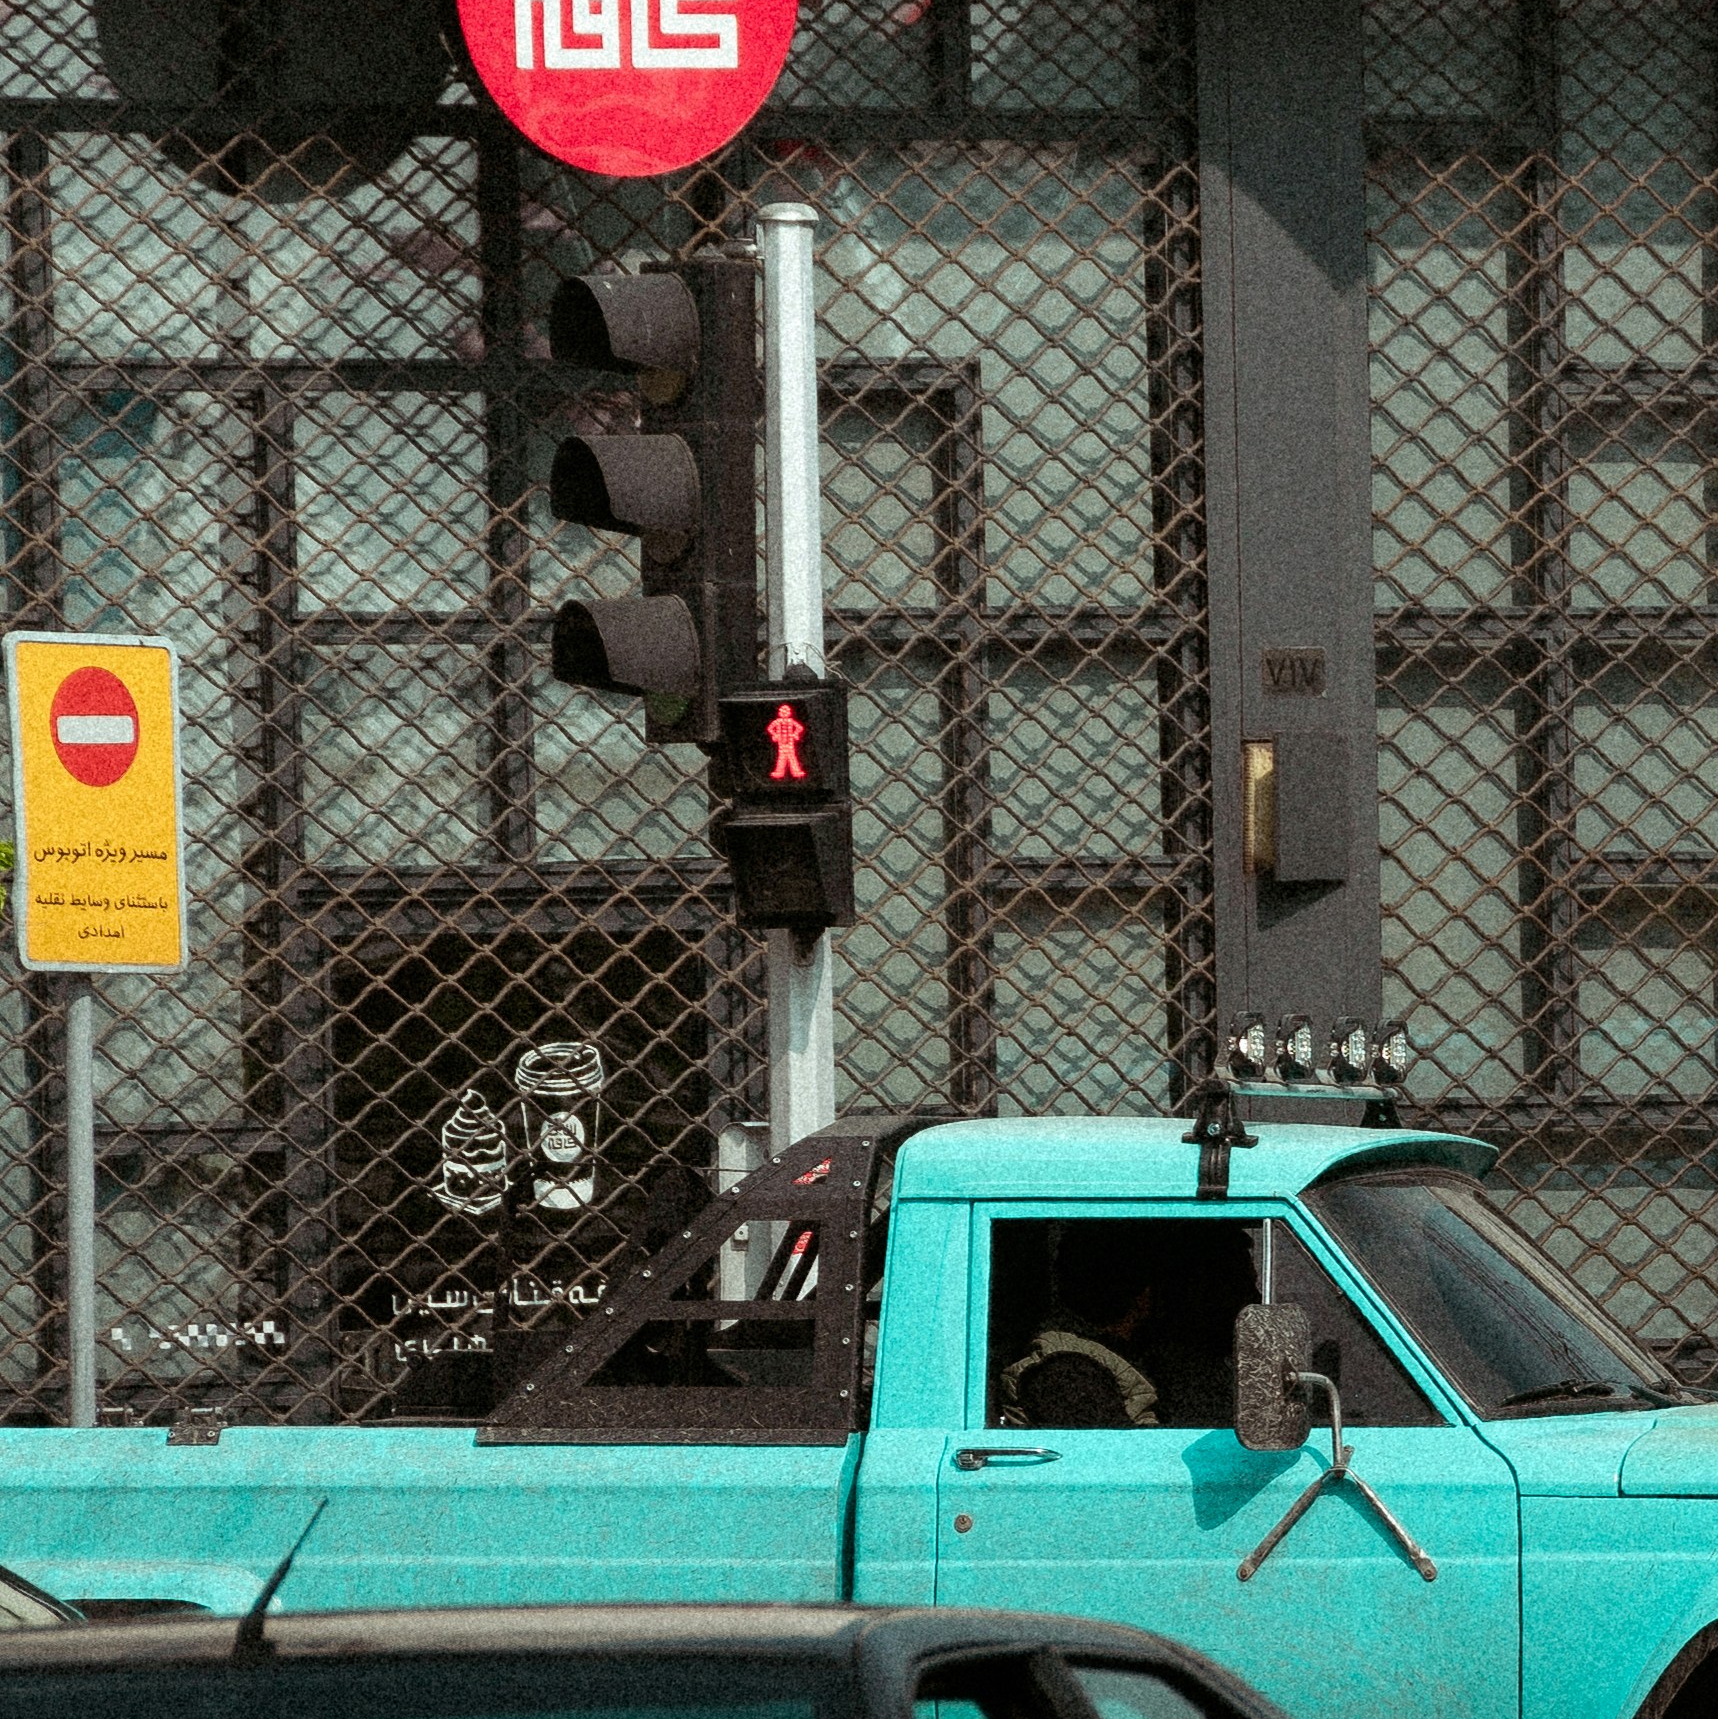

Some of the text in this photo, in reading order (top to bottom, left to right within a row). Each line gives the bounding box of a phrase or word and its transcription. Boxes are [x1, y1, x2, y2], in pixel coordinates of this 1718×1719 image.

[33, 839, 168, 864] مسیر ویژه اتوبوس
[35, 893, 65, 910] نقلیه
[70, 893, 110, 912] وسایط
[78, 925, 125, 940] امدادی
